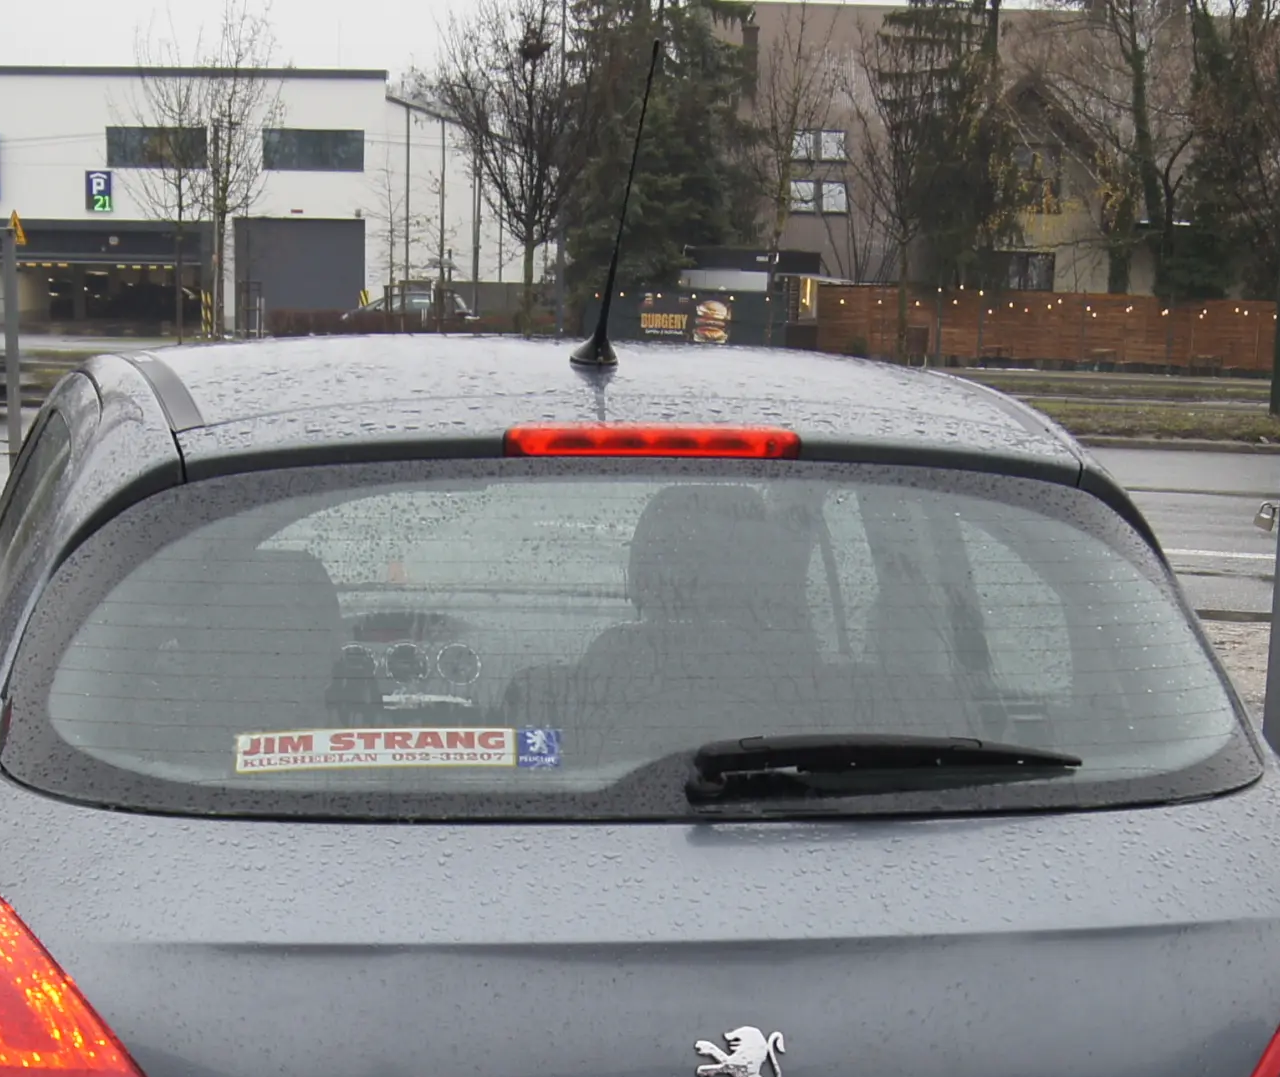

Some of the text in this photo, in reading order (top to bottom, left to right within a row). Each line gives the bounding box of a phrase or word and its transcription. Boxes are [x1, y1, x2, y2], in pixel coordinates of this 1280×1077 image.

[92, 178, 106, 195] P
[94, 196, 112, 211] 21
[640, 312, 689, 330] BURGERY
[242, 731, 506, 756] JIM STRANG
[242, 751, 505, 768] KILSHEELAN 052-33207
